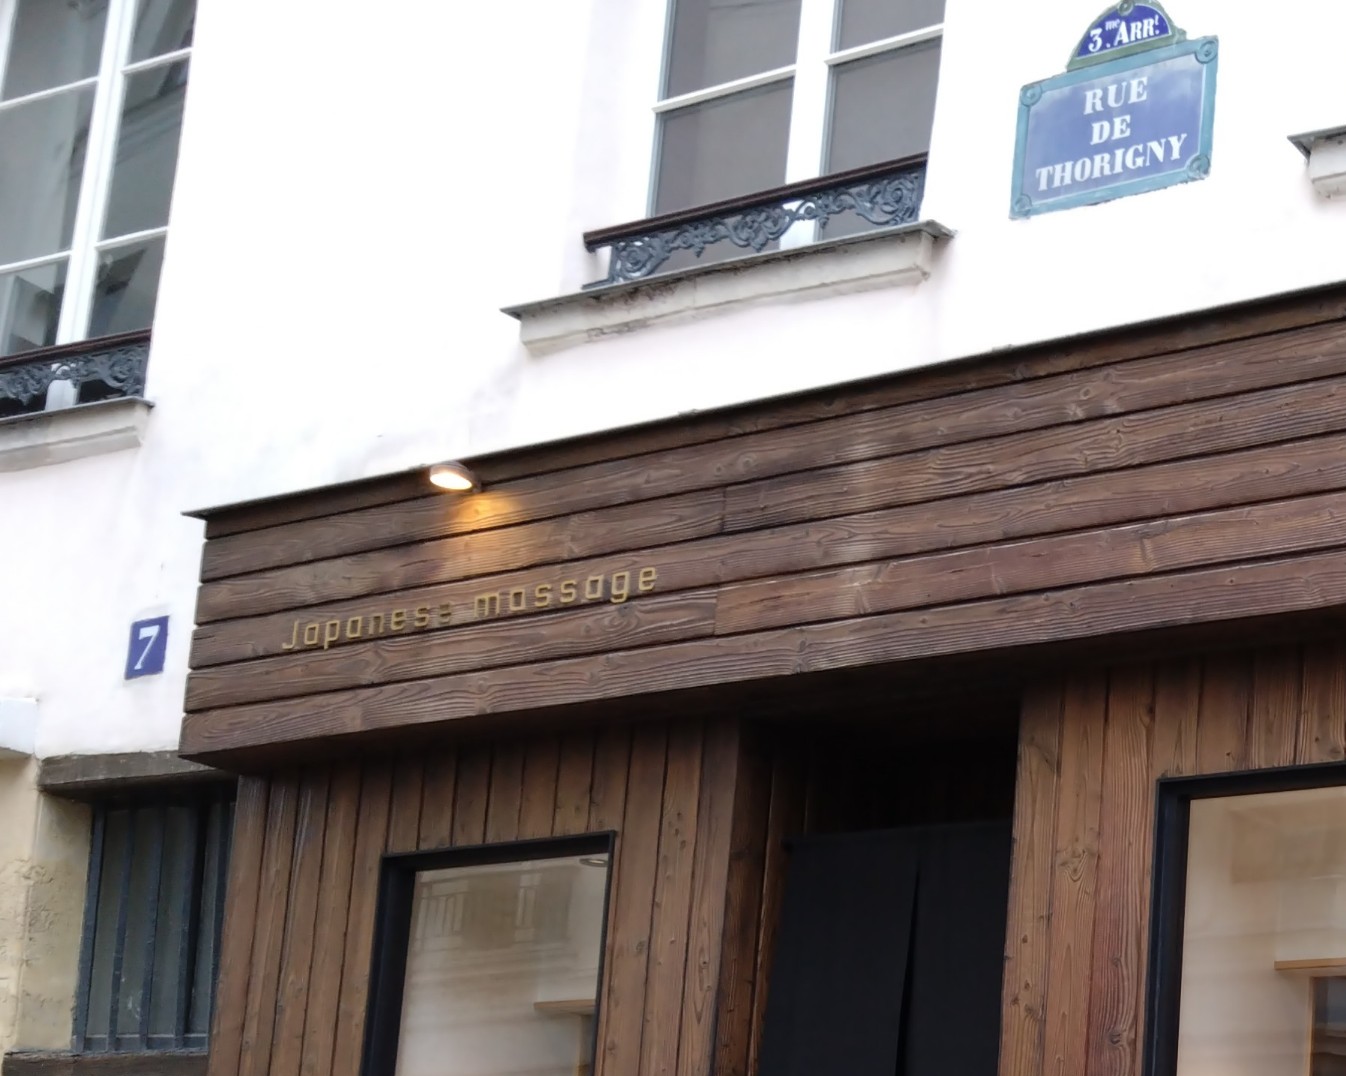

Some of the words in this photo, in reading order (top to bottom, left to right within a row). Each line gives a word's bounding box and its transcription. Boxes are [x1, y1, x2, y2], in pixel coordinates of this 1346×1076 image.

[1083, 76, 1148, 115] RUE
[1090, 115, 1131, 145] DE
[1035, 133, 1188, 191] THORIGNY
[473, 567, 658, 618] massage
[133, 624, 161, 671] 7
